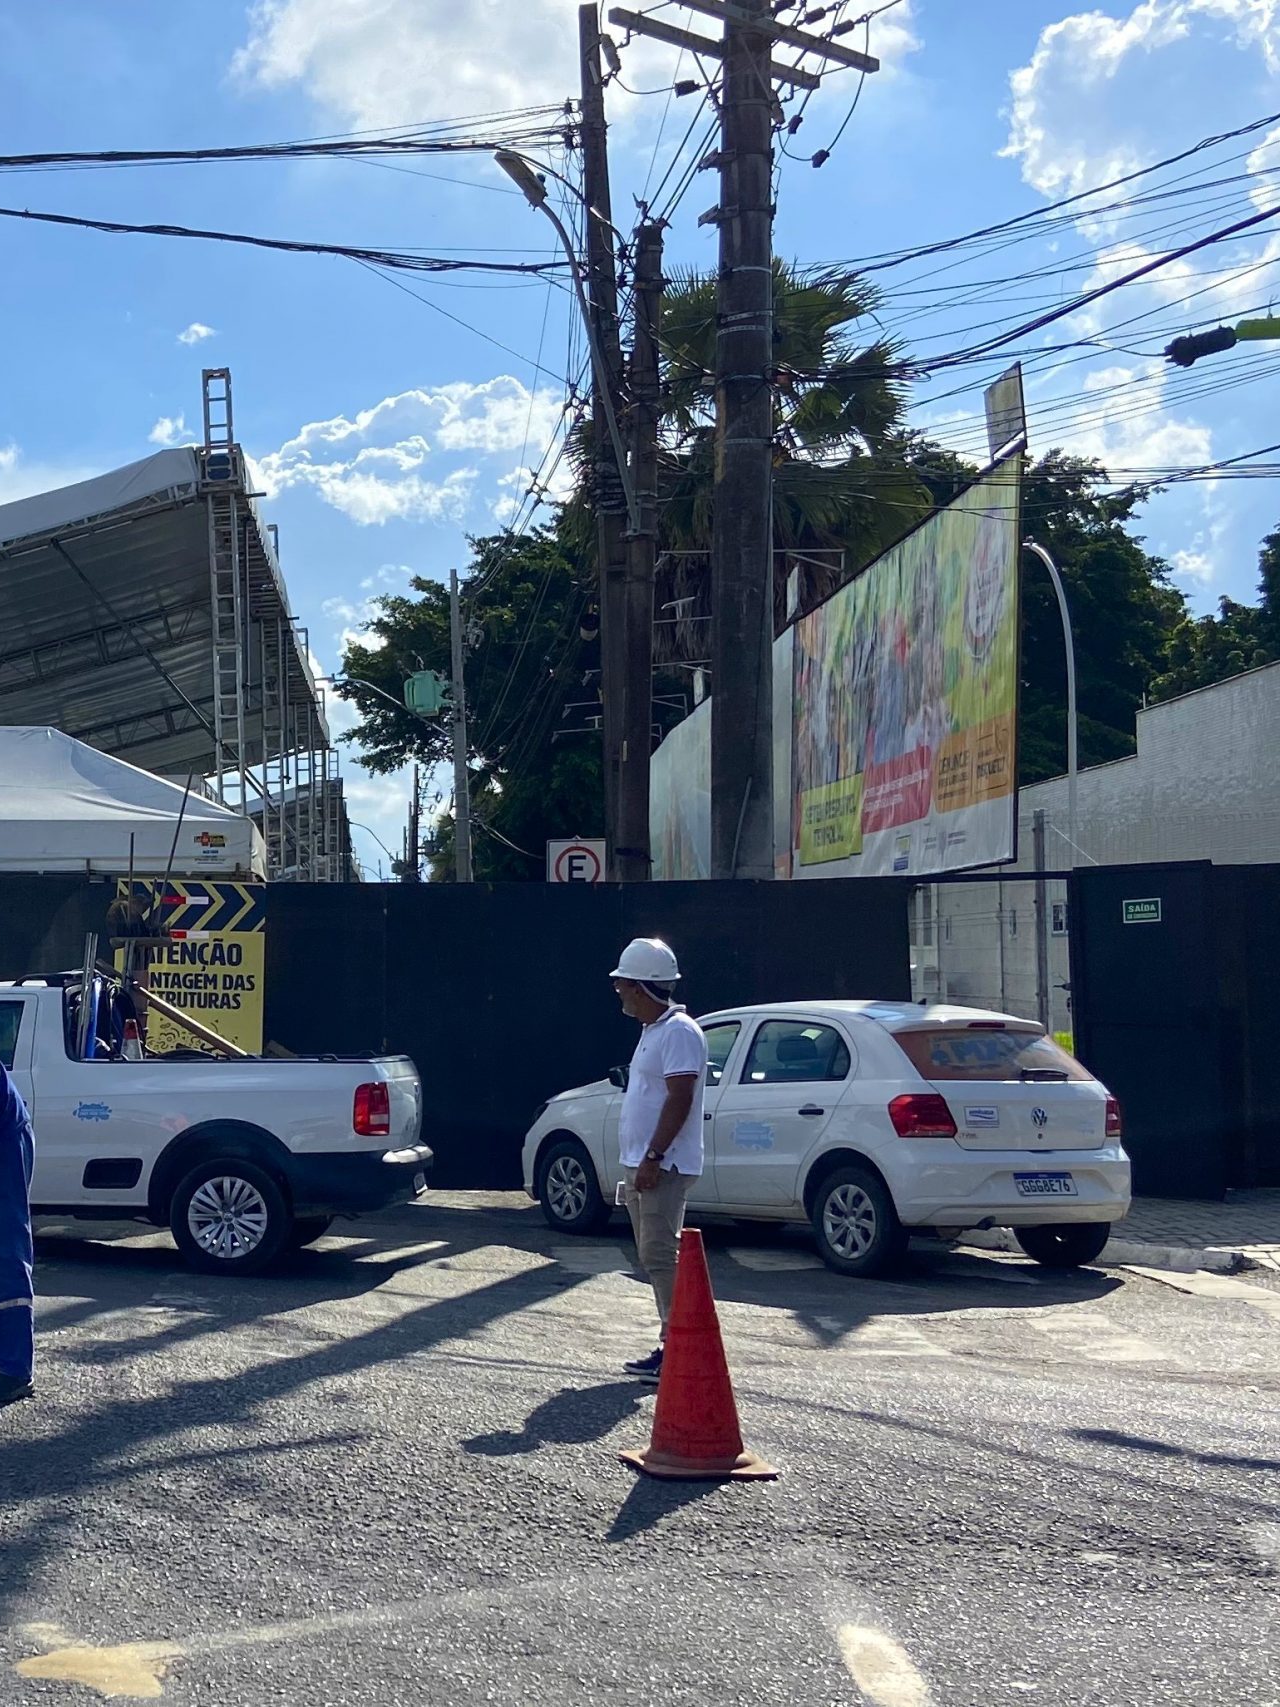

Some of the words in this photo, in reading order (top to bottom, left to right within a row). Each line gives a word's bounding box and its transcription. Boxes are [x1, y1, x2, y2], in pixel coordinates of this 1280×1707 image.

[568, 855, 586, 882] E
[1127, 903, 1156, 912] SAÍDA
[150, 972, 218, 990] NTAGEM
[222, 974, 255, 991] DAS
[149, 991, 241, 1009] TRUTURAS
